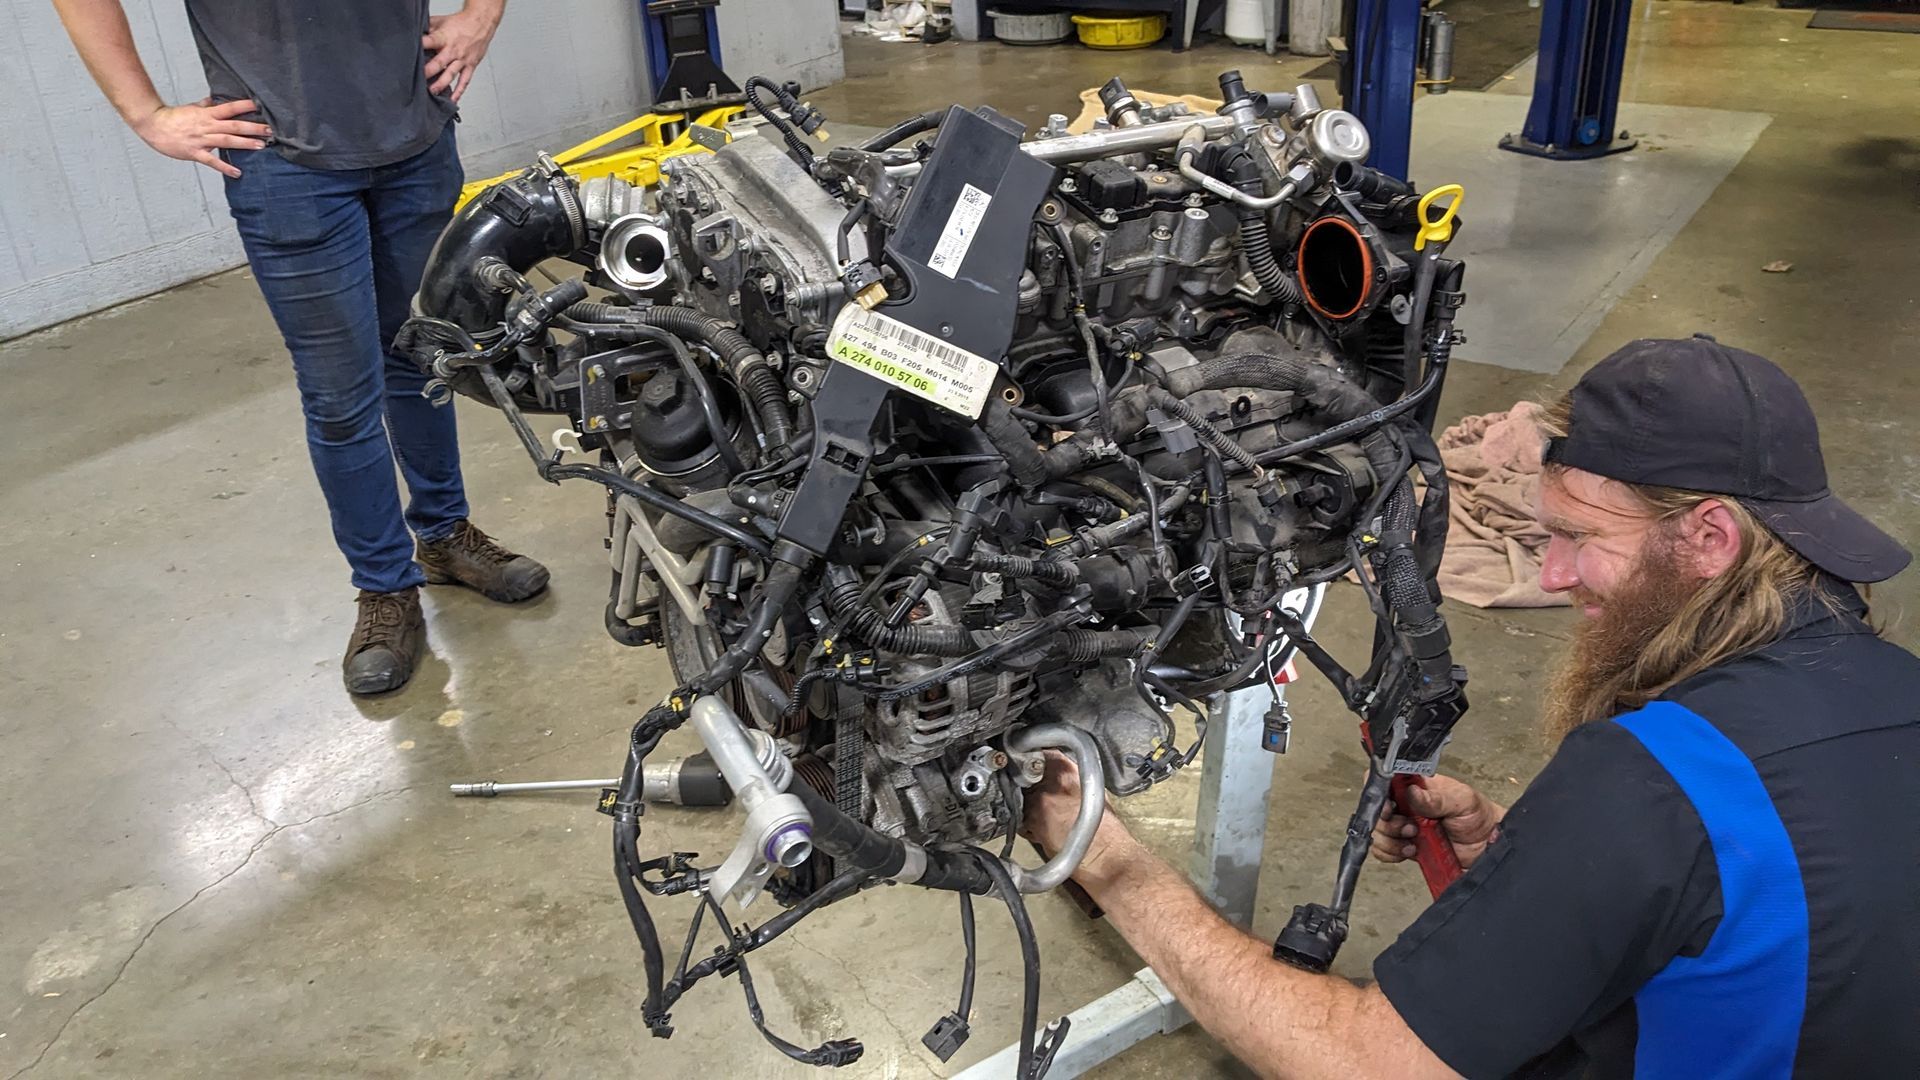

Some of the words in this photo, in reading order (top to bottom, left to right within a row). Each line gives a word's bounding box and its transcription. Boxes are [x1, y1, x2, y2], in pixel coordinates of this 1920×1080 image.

[838, 346, 848, 357] A
[850, 351, 873, 367] 274
[874, 361, 896, 377] 010
[897, 371, 912, 384] 57
[913, 378, 928, 391] 06
[842, 332, 858, 342] 427
[862, 341, 877, 352] 494
[881, 348, 898, 360] B03
[901, 357, 923, 371] F205
[925, 368, 948, 382] M014
[951, 379, 974, 393] M005
